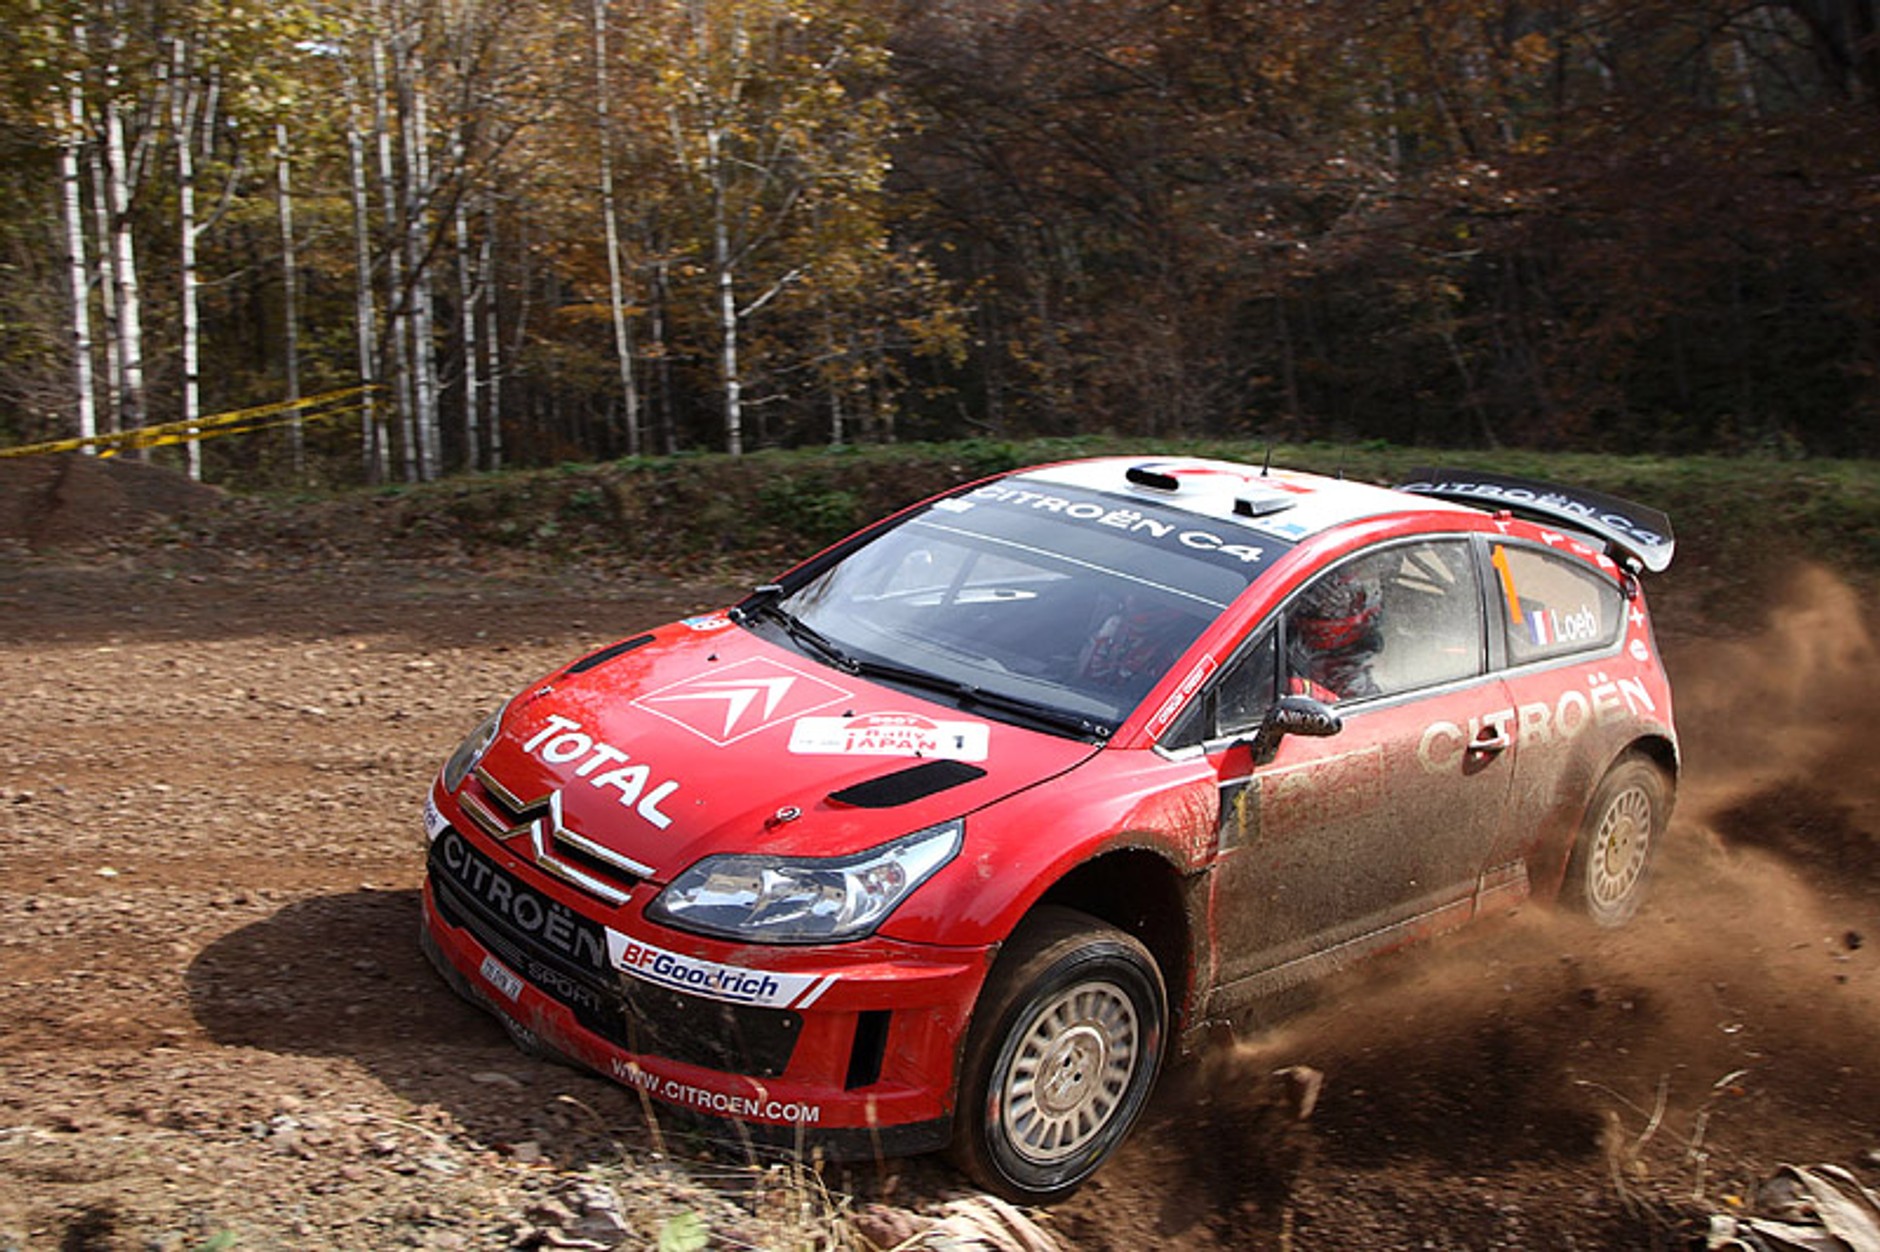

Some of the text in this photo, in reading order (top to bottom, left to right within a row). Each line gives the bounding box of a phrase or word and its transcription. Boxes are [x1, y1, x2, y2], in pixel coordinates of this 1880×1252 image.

[973, 486, 1264, 563] CITROËN C4
[1401, 481, 1663, 547] CITROËN C4
[1491, 544, 1523, 625] 1
[1551, 604, 1597, 642] Loeb
[1417, 671, 1656, 774] CITROËN
[523, 713, 681, 830] TOTAL
[443, 833, 605, 969] CITROËN
[622, 942, 780, 998] BFGoodrich
[611, 1057, 820, 1123] WWW.CITROEN.COM
